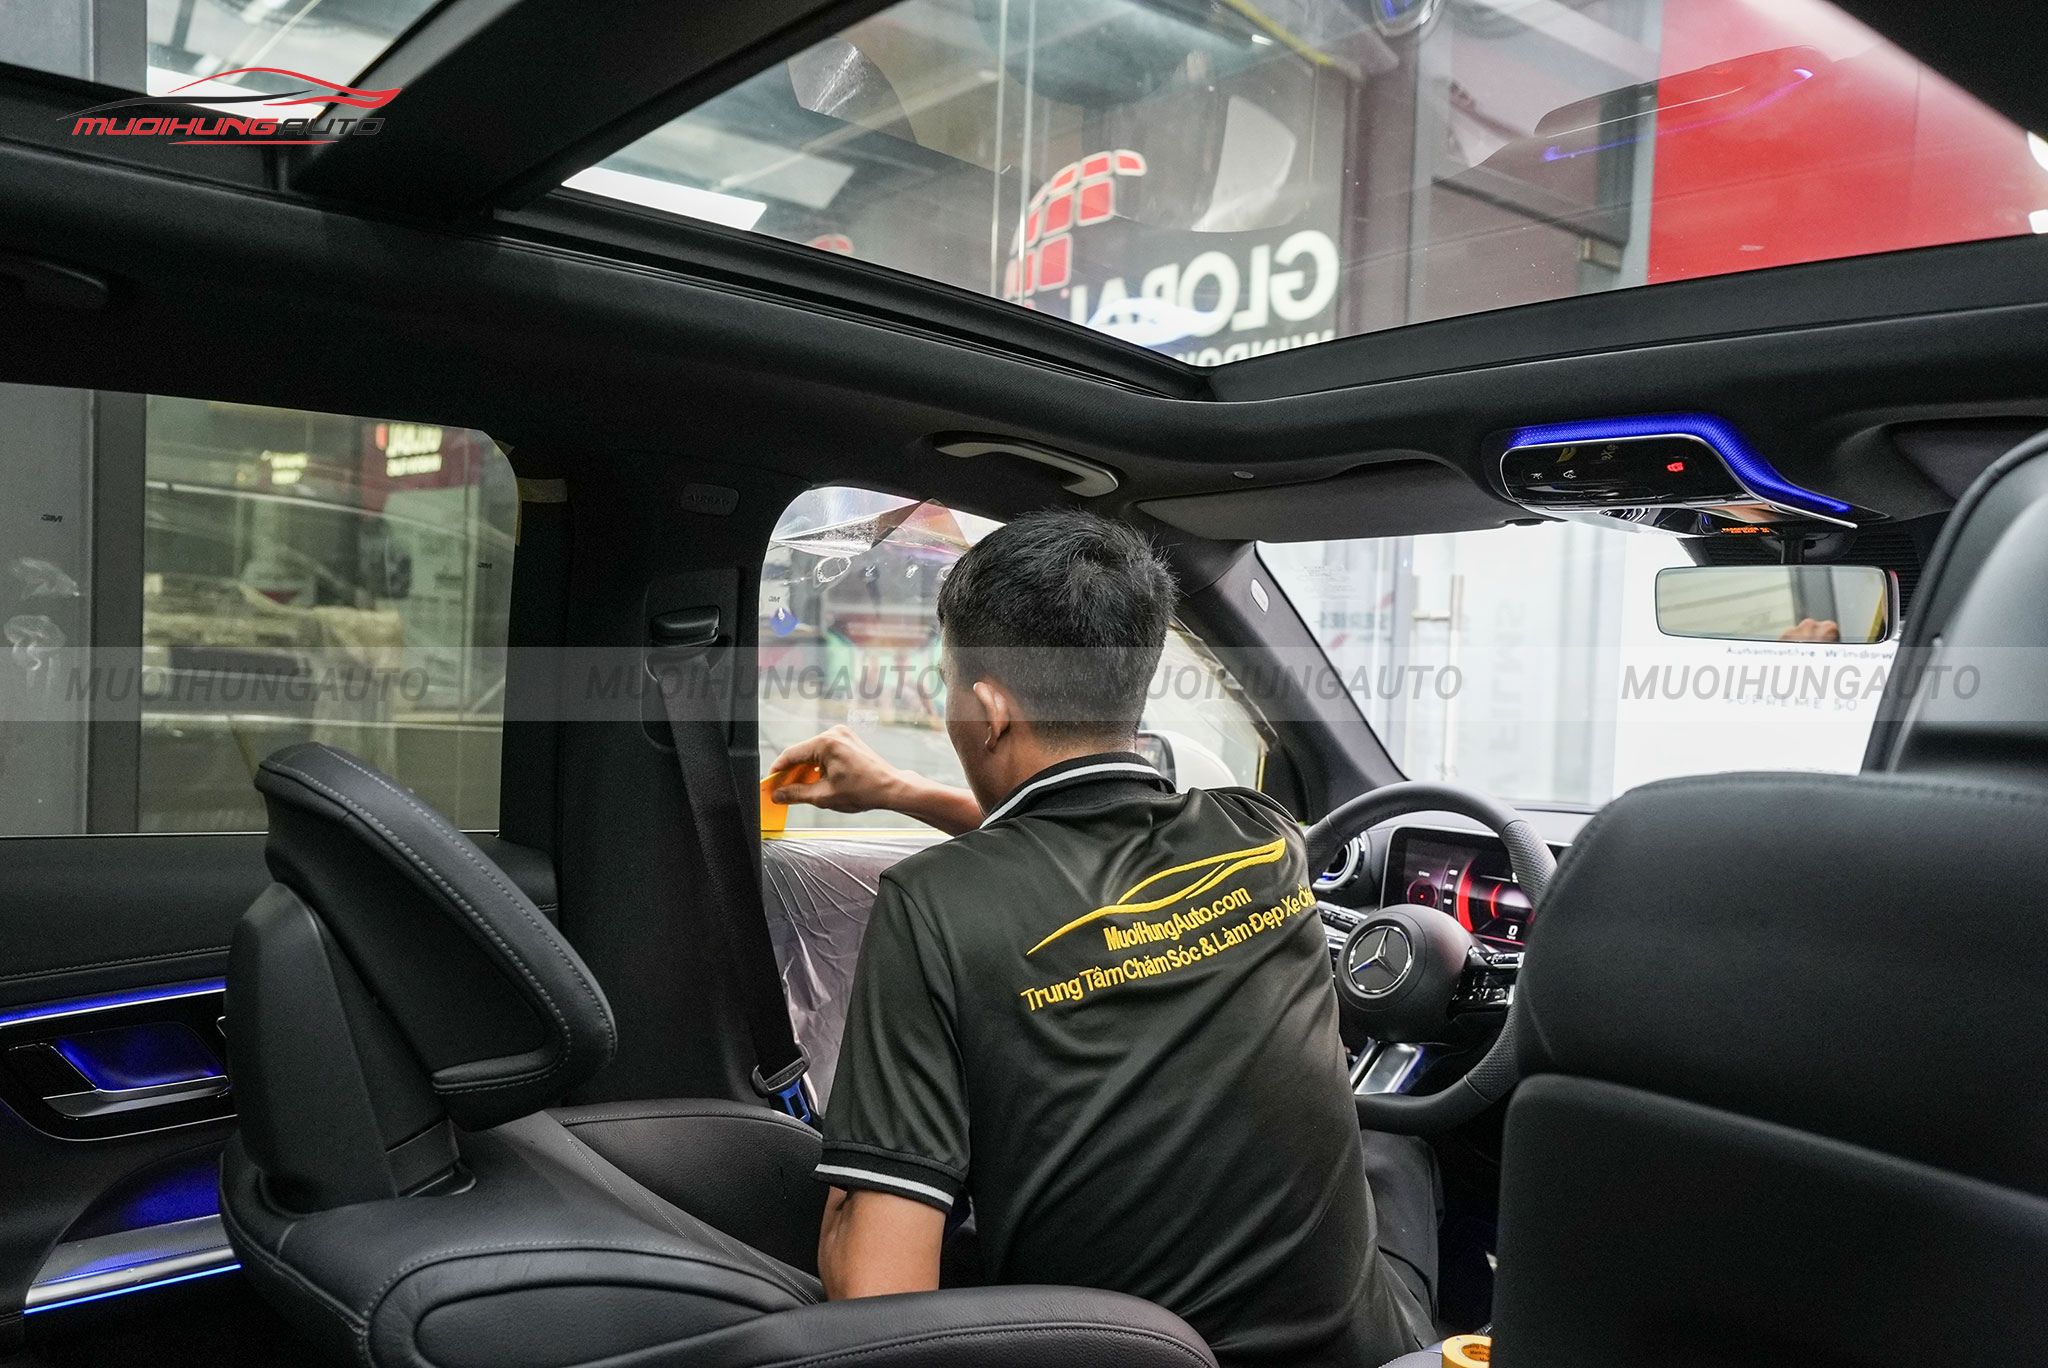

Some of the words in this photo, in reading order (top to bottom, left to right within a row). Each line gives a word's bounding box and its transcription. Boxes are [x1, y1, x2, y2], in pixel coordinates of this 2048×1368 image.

[41, 514, 63, 522] 3M
[1103, 886, 1252, 951] MuoiHungAuto.com
[1020, 976, 1084, 1012] Trung
[1079, 965, 1125, 991] Tâm
[1121, 954, 1171, 981] Chăm
[1168, 944, 1201, 969] Sóc
[1199, 937, 1217, 958] &
[1211, 923, 1253, 954] Làm
[1248, 905, 1285, 933] Đẹp
[1280, 895, 1301, 917] Xe
